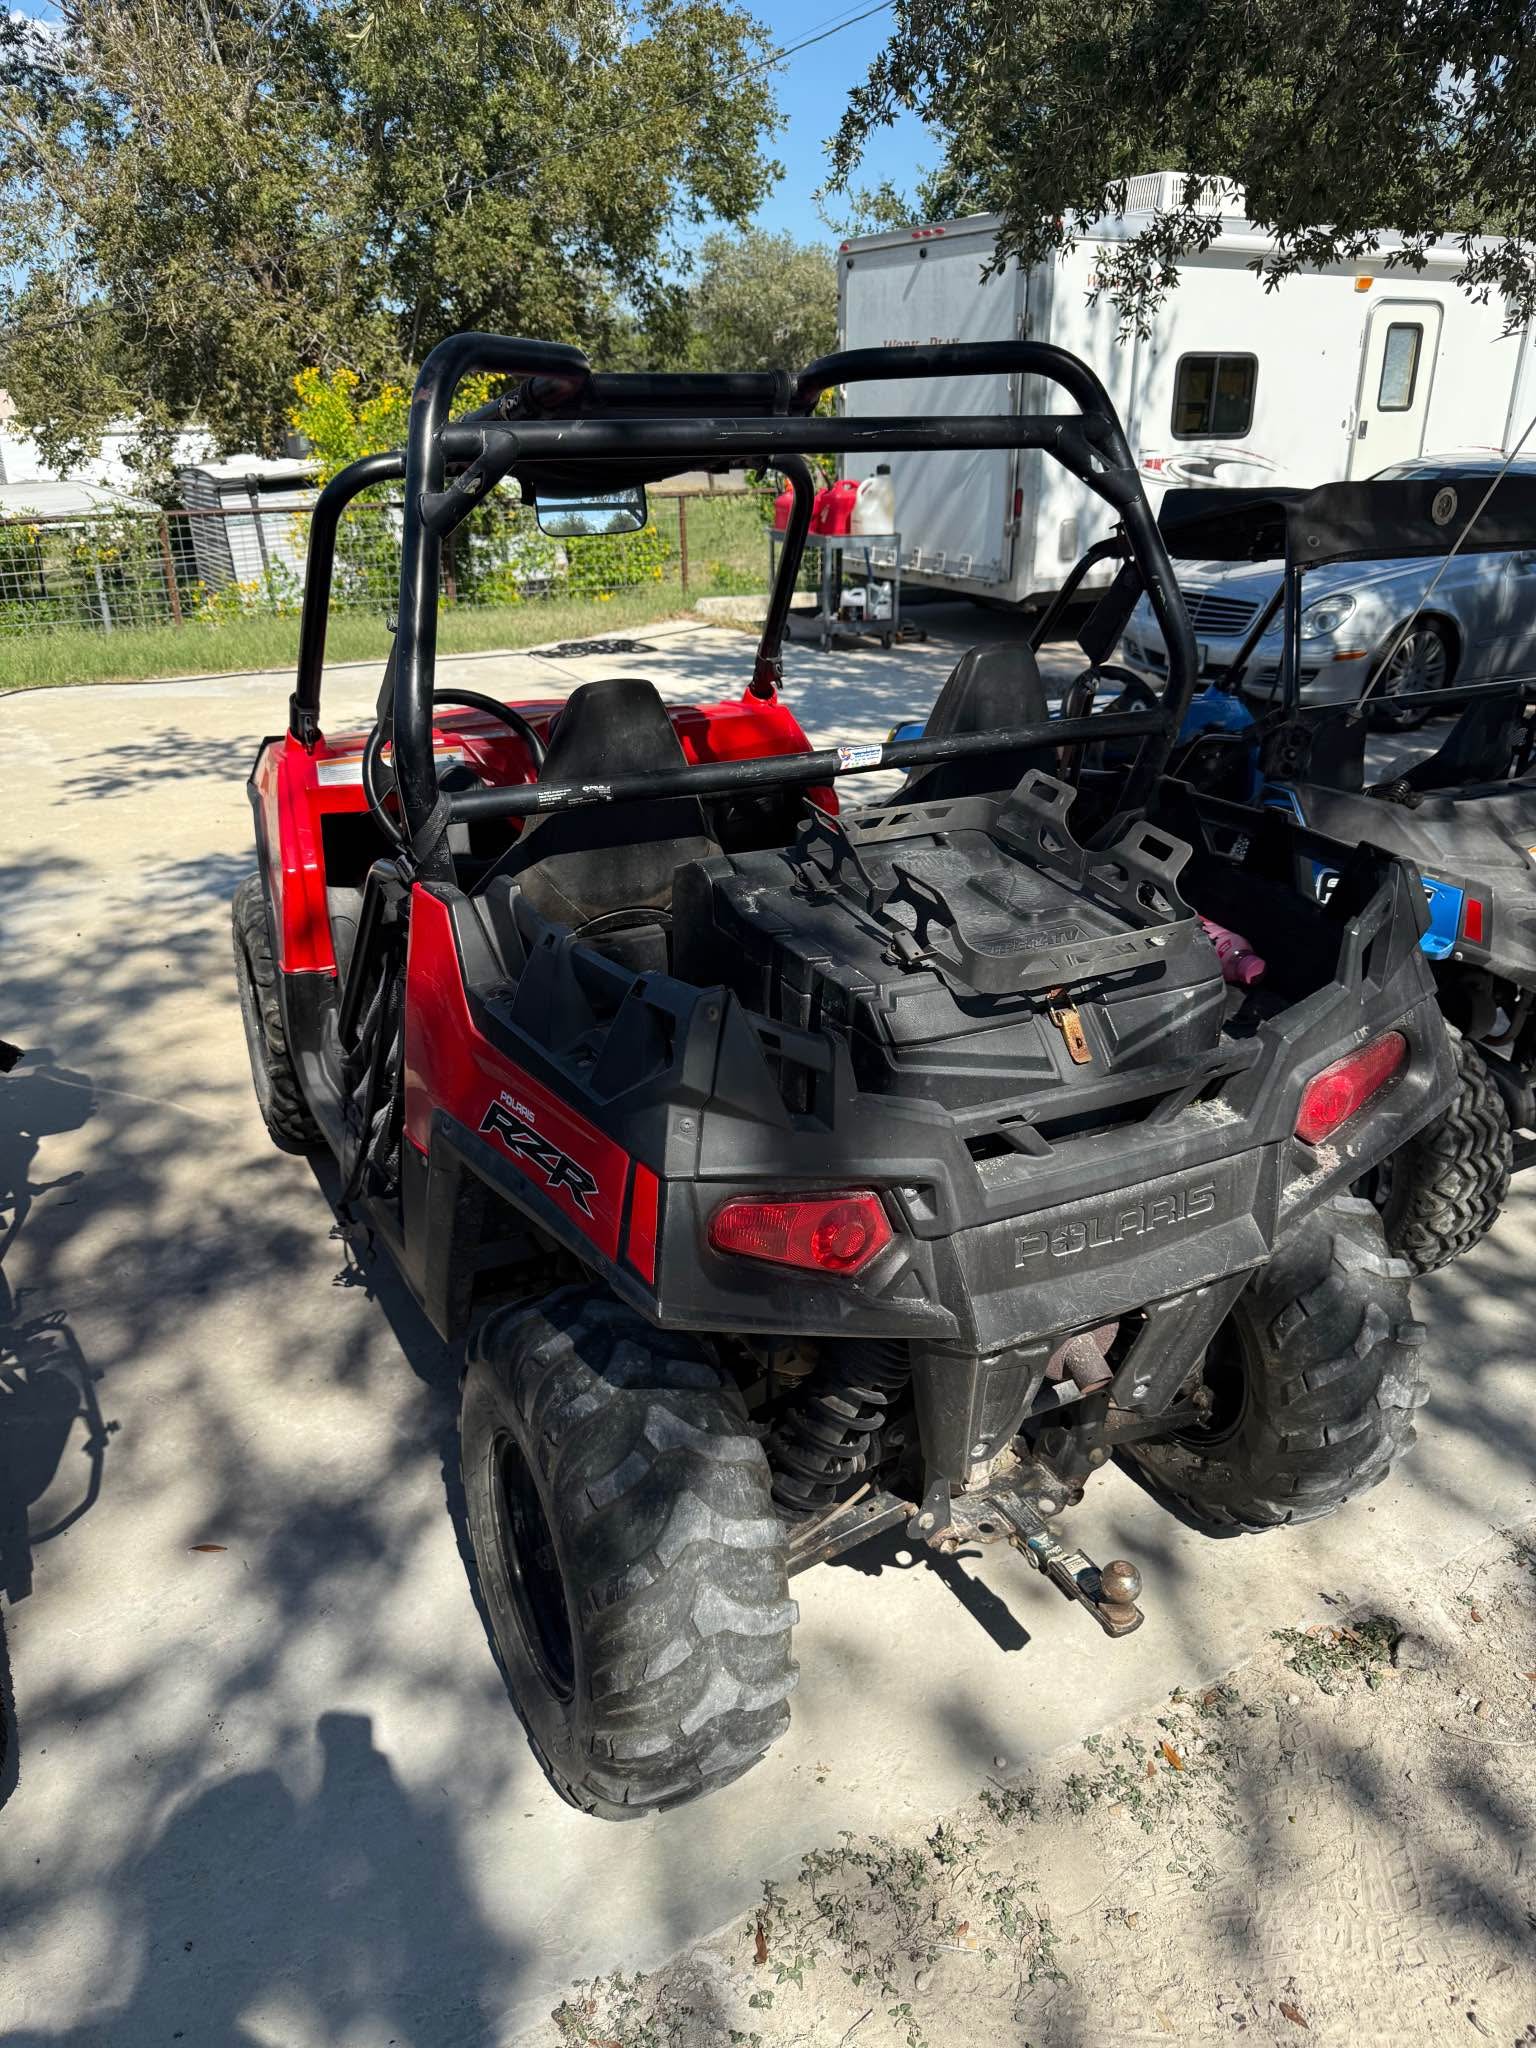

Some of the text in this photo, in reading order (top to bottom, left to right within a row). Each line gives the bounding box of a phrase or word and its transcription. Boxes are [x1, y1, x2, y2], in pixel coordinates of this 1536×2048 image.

[500, 1091, 535, 1123] POLARIS
[478, 1100, 599, 1220] RZR
[1014, 1182, 1216, 1269] POLARIS
